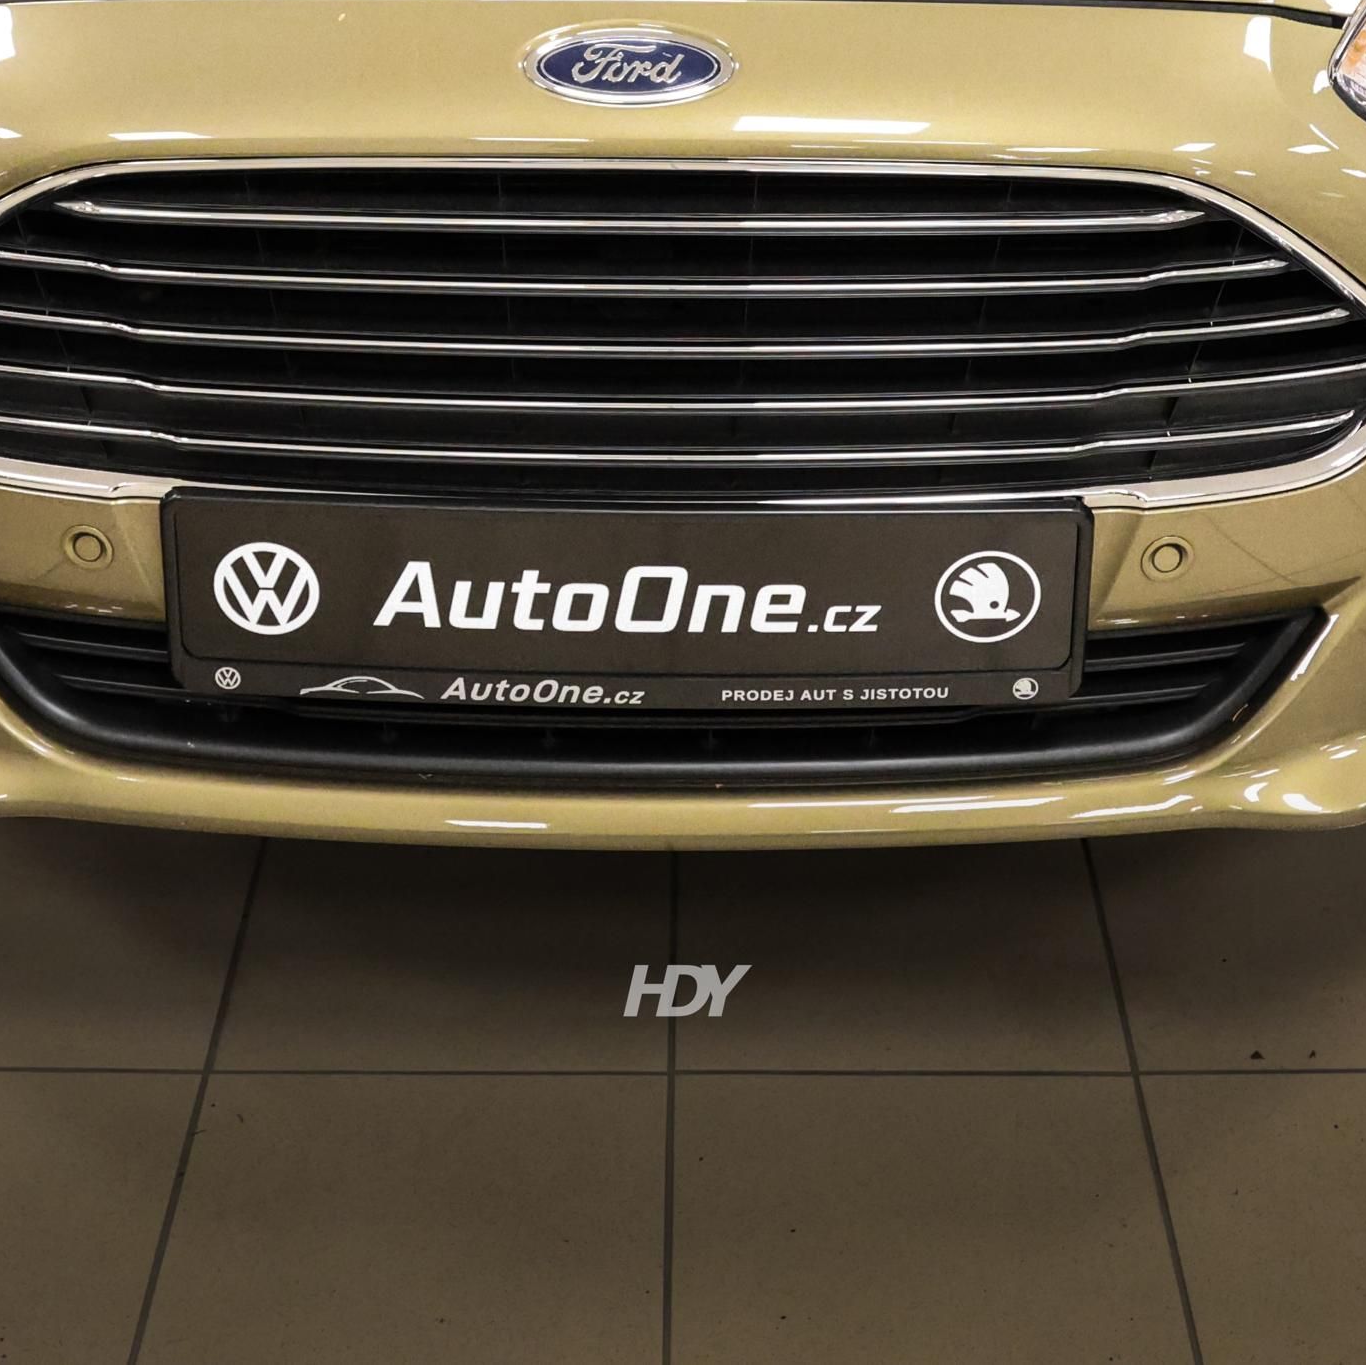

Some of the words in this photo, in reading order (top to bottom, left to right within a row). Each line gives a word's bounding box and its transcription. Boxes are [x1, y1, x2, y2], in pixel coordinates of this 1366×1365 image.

[571, 42, 684, 85] Ford
[372, 560, 883, 634] AutoOne.cz
[440, 676, 646, 705] AutoOne.cz
[721, 689, 795, 702] PRODEJ
[799, 689, 838, 701] AUT
[842, 688, 854, 701] S
[860, 686, 950, 701] JISTOTOU
